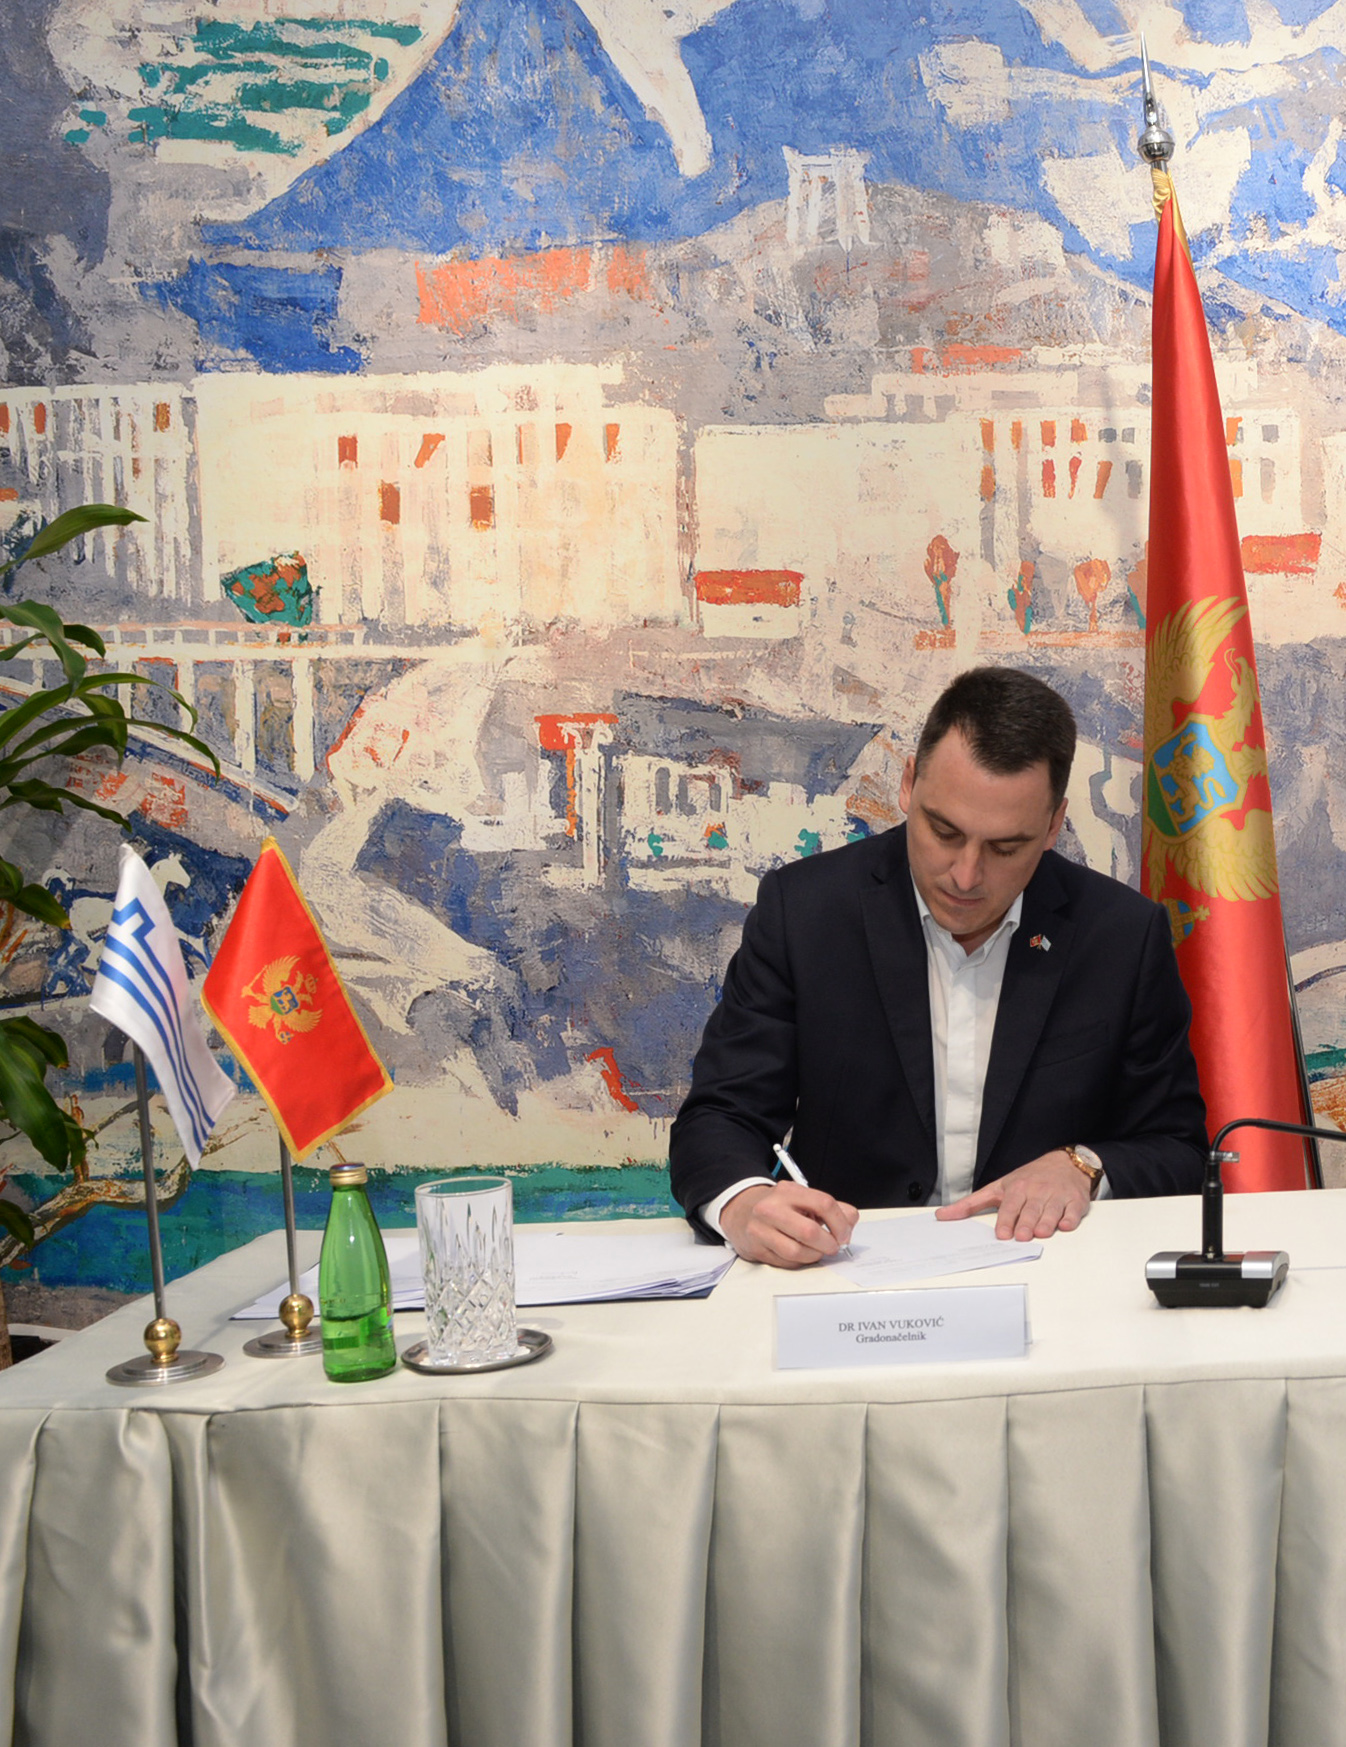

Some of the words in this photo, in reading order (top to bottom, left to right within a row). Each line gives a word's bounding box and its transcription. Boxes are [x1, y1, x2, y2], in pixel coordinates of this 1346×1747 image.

[838, 1322, 855, 1332] DR
[858, 1320, 886, 1331] IVAN
[889, 1316, 944, 1329] VUKOVIĆ
[855, 1331, 927, 1344] Gradonačelnik
